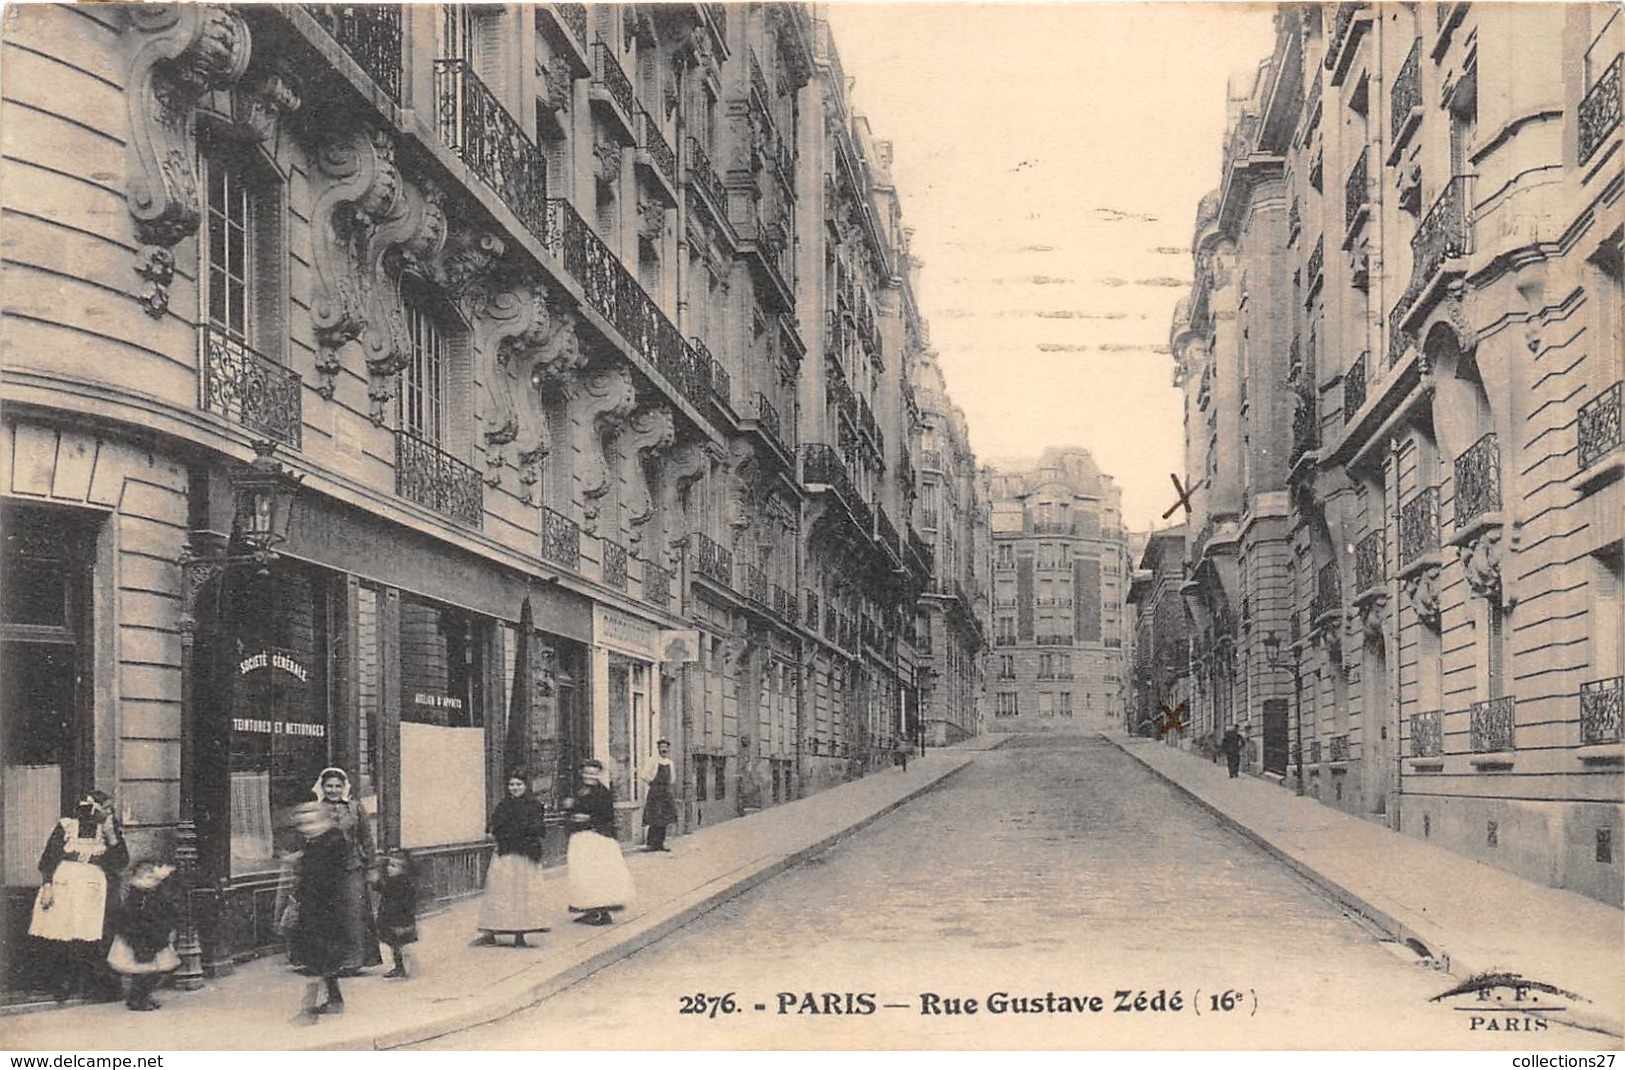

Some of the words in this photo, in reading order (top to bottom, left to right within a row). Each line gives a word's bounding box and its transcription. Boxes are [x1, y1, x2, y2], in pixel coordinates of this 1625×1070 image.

[233, 718, 271, 733] TEINTURES
[274, 721, 283, 734] ET
[285, 722, 325, 737] NETTOYAGES
